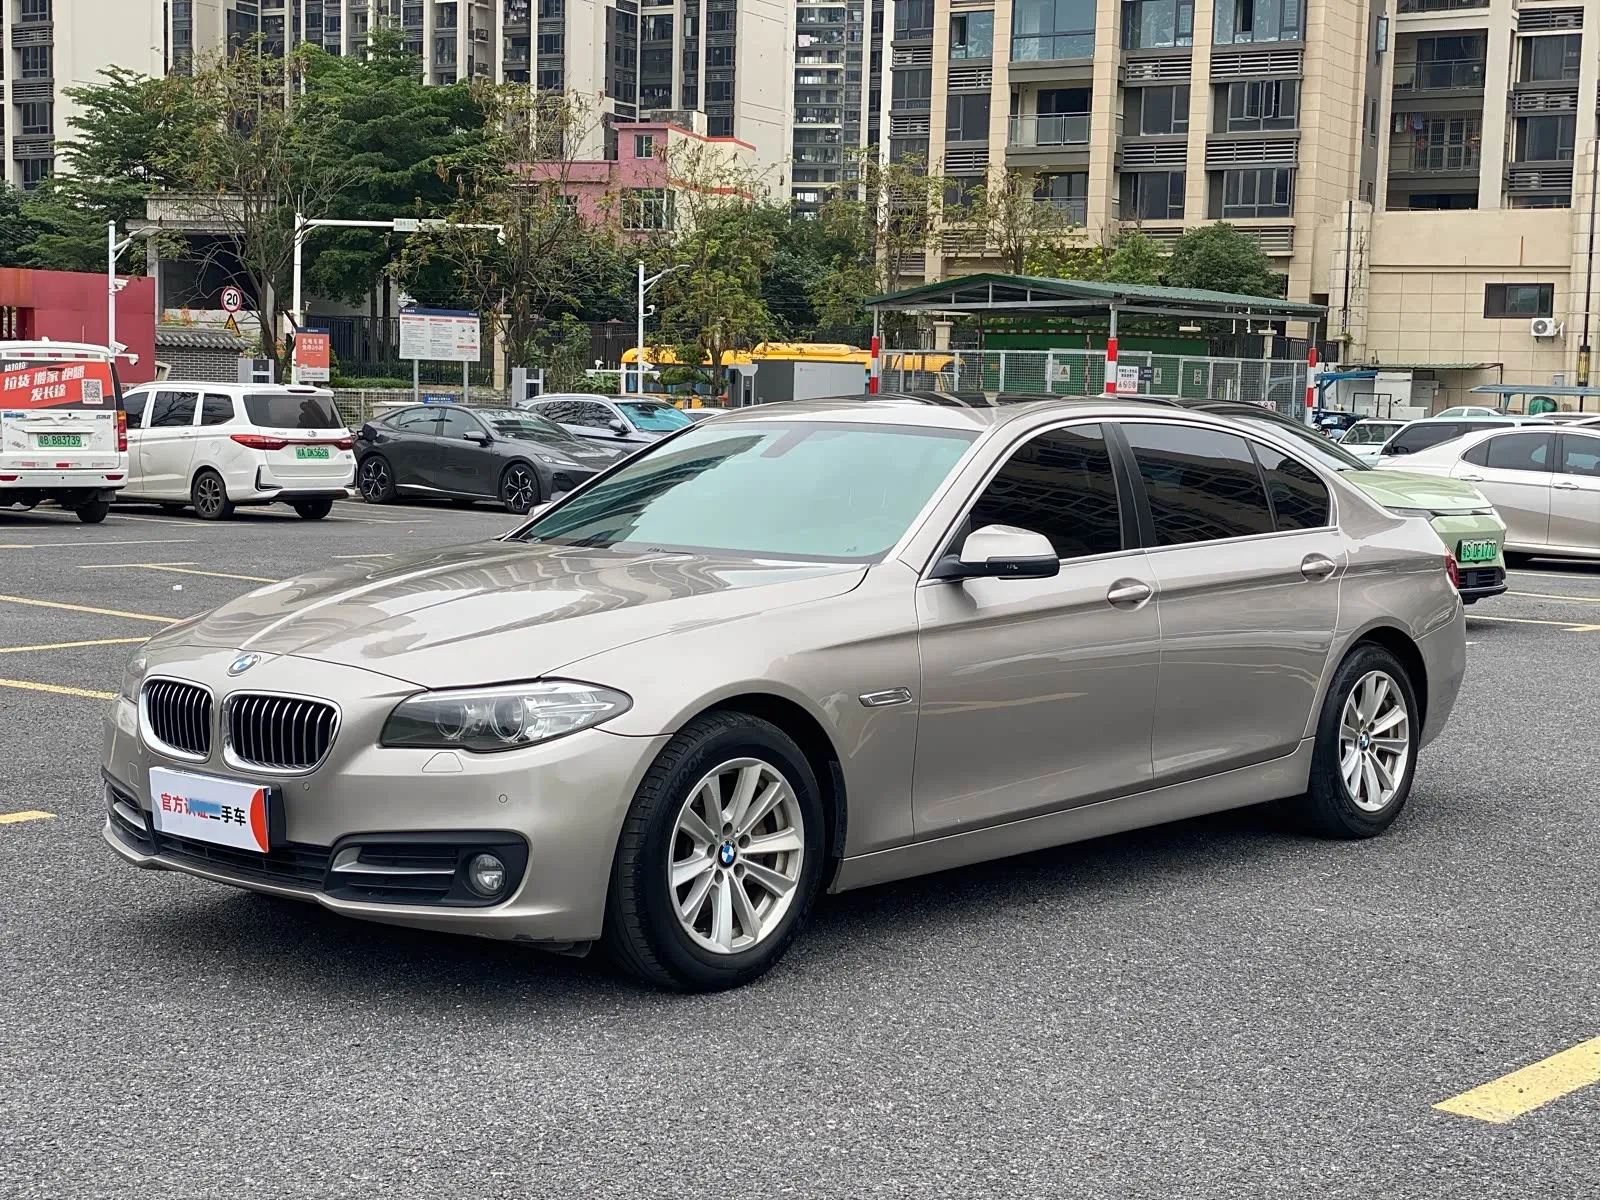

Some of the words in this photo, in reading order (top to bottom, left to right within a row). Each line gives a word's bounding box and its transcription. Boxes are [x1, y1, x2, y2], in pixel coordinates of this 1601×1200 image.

[226, 292, 238, 306] 20
[4, 374, 31, 391] 拉货
[34, 370, 59, 385] 搬家
[30, 384, 66, 402] 发长途
[52, 435, 81, 445] B83739
[161, 793, 247, 826] 官方手车
